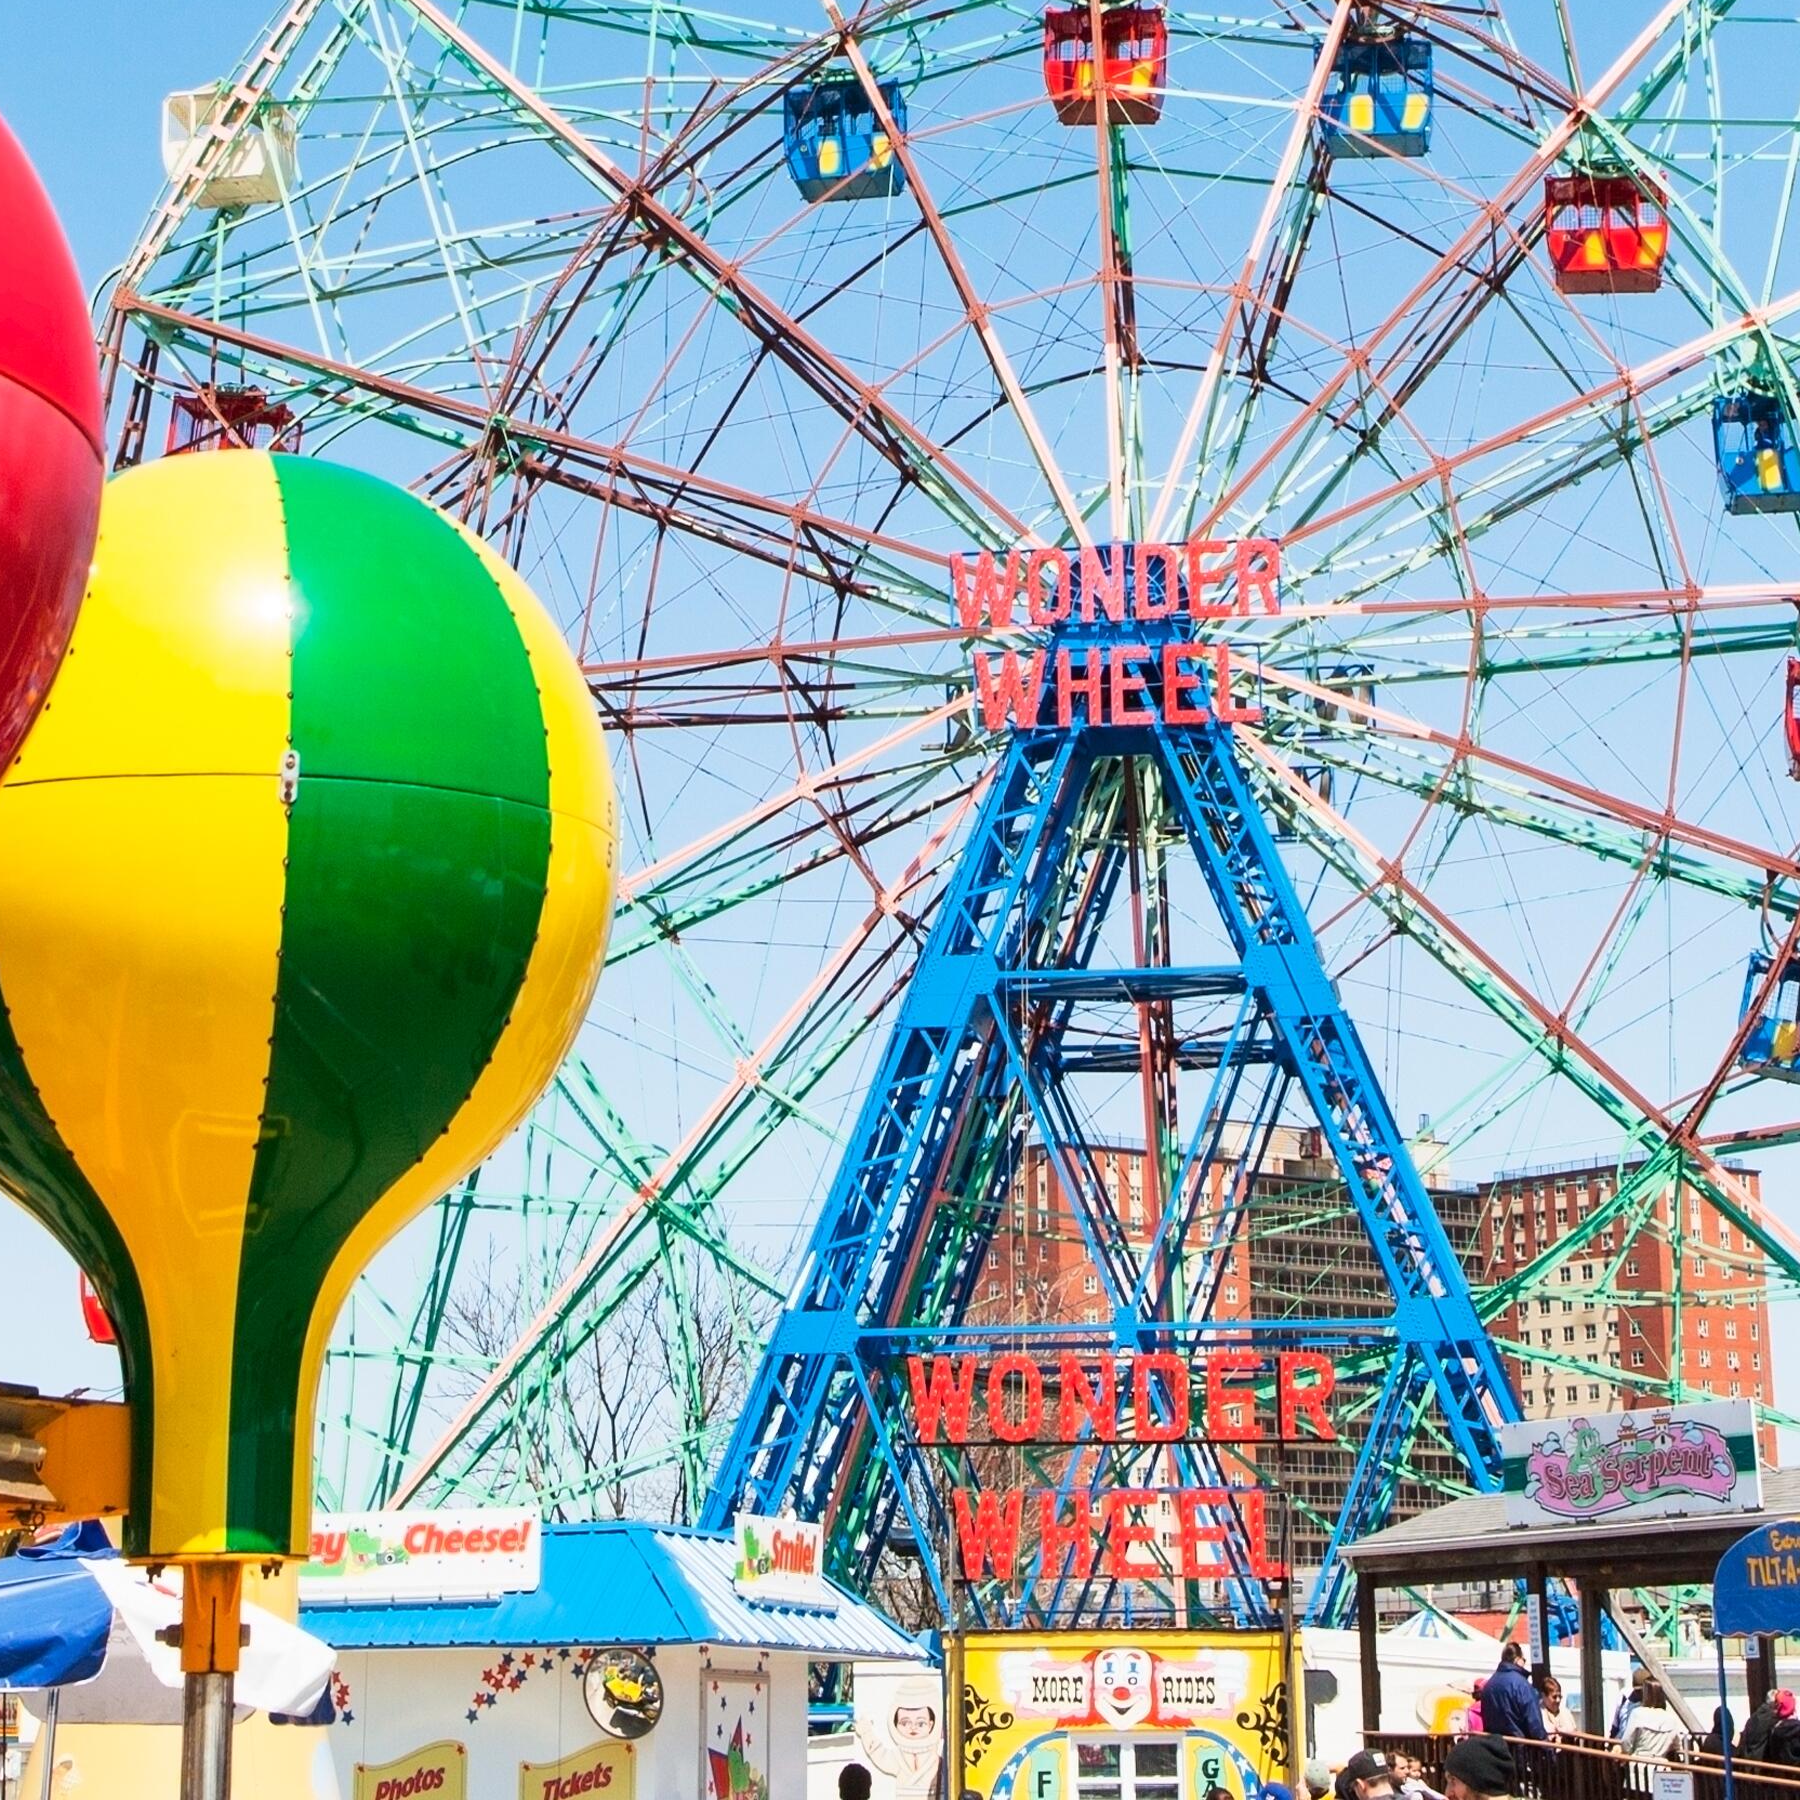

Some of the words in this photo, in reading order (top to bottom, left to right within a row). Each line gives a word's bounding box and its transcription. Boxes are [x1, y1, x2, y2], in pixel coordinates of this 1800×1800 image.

[950, 539, 1281, 627] WONDER
[973, 642, 1262, 730] WHEEL
[908, 1352, 1336, 1443] WONDER
[1544, 1464, 1596, 1500] Sea
[1599, 1443, 1713, 1492] Serpent
[312, 1531, 346, 1565] ay
[404, 1521, 531, 1554] Cheese!
[771, 1529, 817, 1574] Smile!
[953, 1489, 1287, 1580] WHEEL
[1032, 1676, 1083, 1704] MORE
[1162, 1676, 1216, 1704] RIDES
[375, 1767, 445, 1800] Photos
[543, 1762, 612, 1800] Tickets
